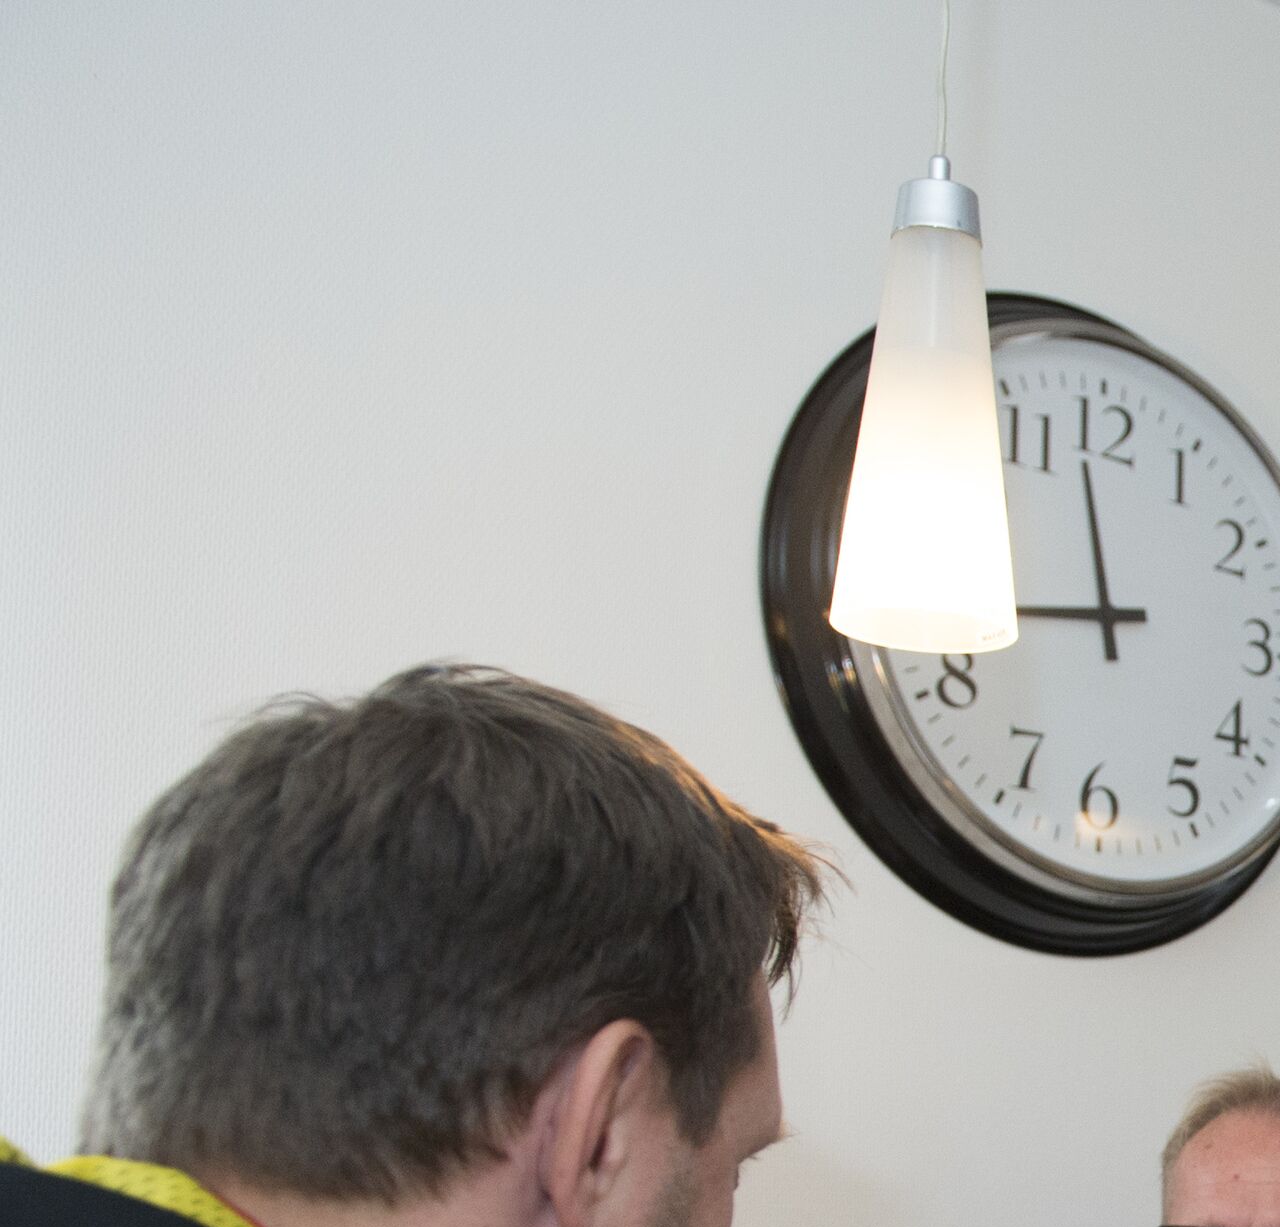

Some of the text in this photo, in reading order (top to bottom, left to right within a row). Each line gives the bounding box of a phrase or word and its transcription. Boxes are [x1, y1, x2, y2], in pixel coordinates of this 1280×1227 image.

[1001, 403, 1058, 477] 11
[1073, 395, 1135, 468] 12
[1171, 446, 1189, 507] 1
[1213, 518, 1247, 578] 2
[1242, 617, 1273, 677] 3
[934, 653, 979, 709] 8
[1009, 726, 1046, 792] 7
[1213, 699, 1251, 758] 4
[1080, 761, 1120, 830] 6
[1167, 756, 1200, 818] 5
